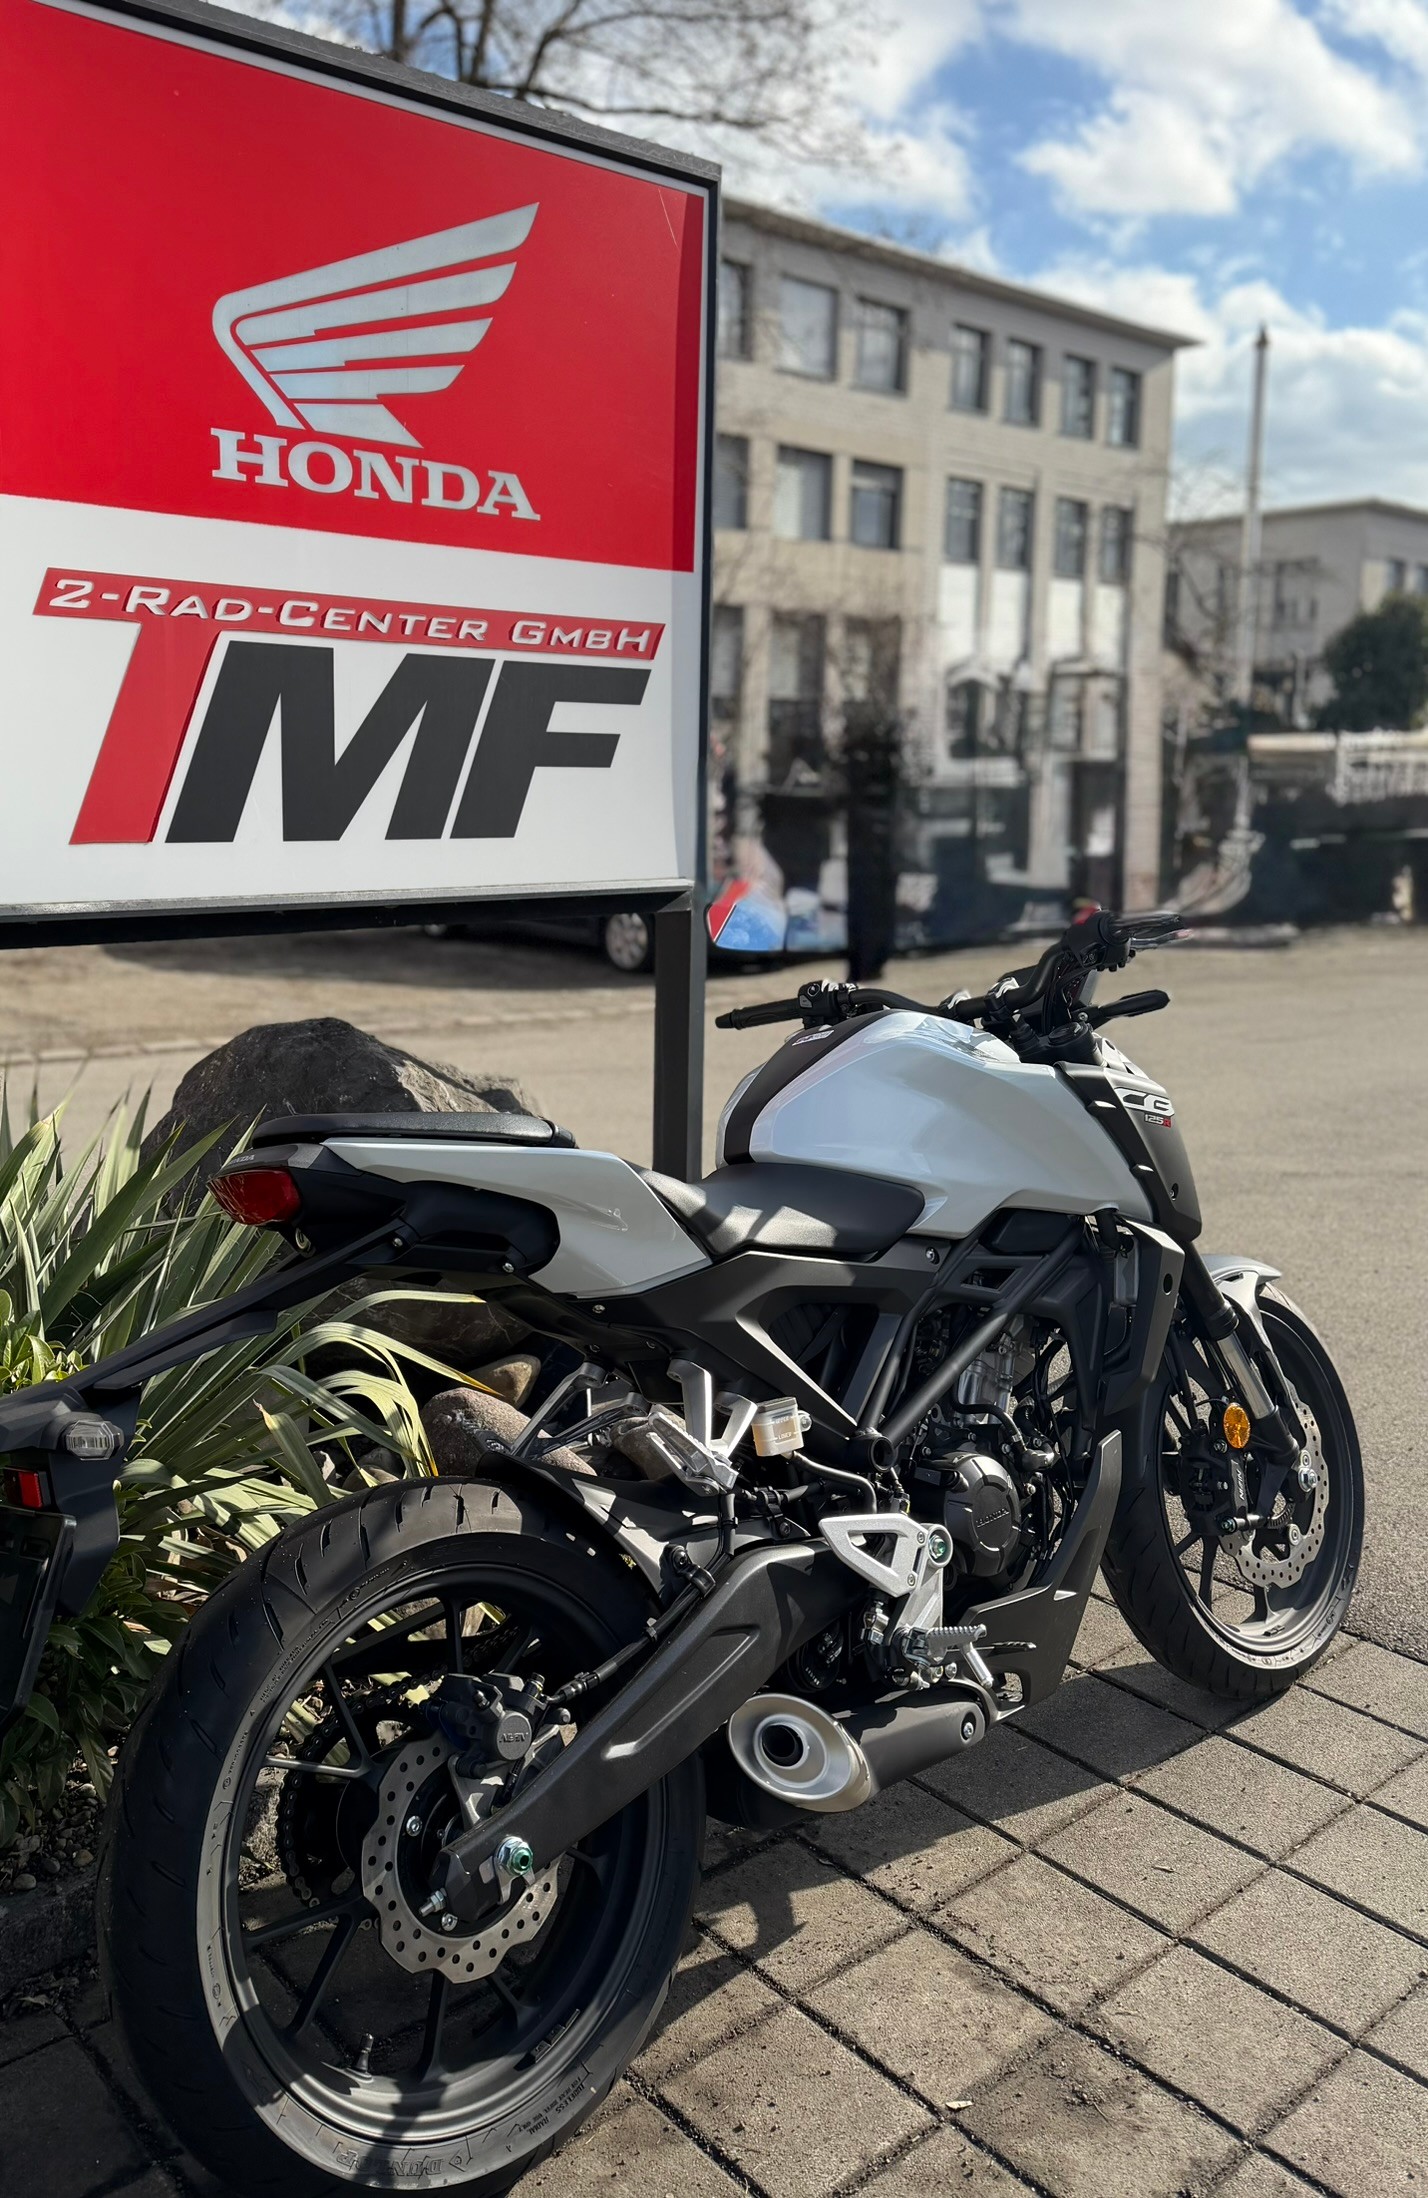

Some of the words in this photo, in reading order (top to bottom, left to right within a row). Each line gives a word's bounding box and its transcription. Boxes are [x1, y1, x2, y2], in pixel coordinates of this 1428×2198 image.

[210, 427, 541, 521] HONDA
[48, 578, 487, 642] 2-RAD-CENTER
[33, 590, 652, 845] TMF
[1114, 1087, 1175, 1117] CB
[1144, 1113, 1172, 1128] 125R
